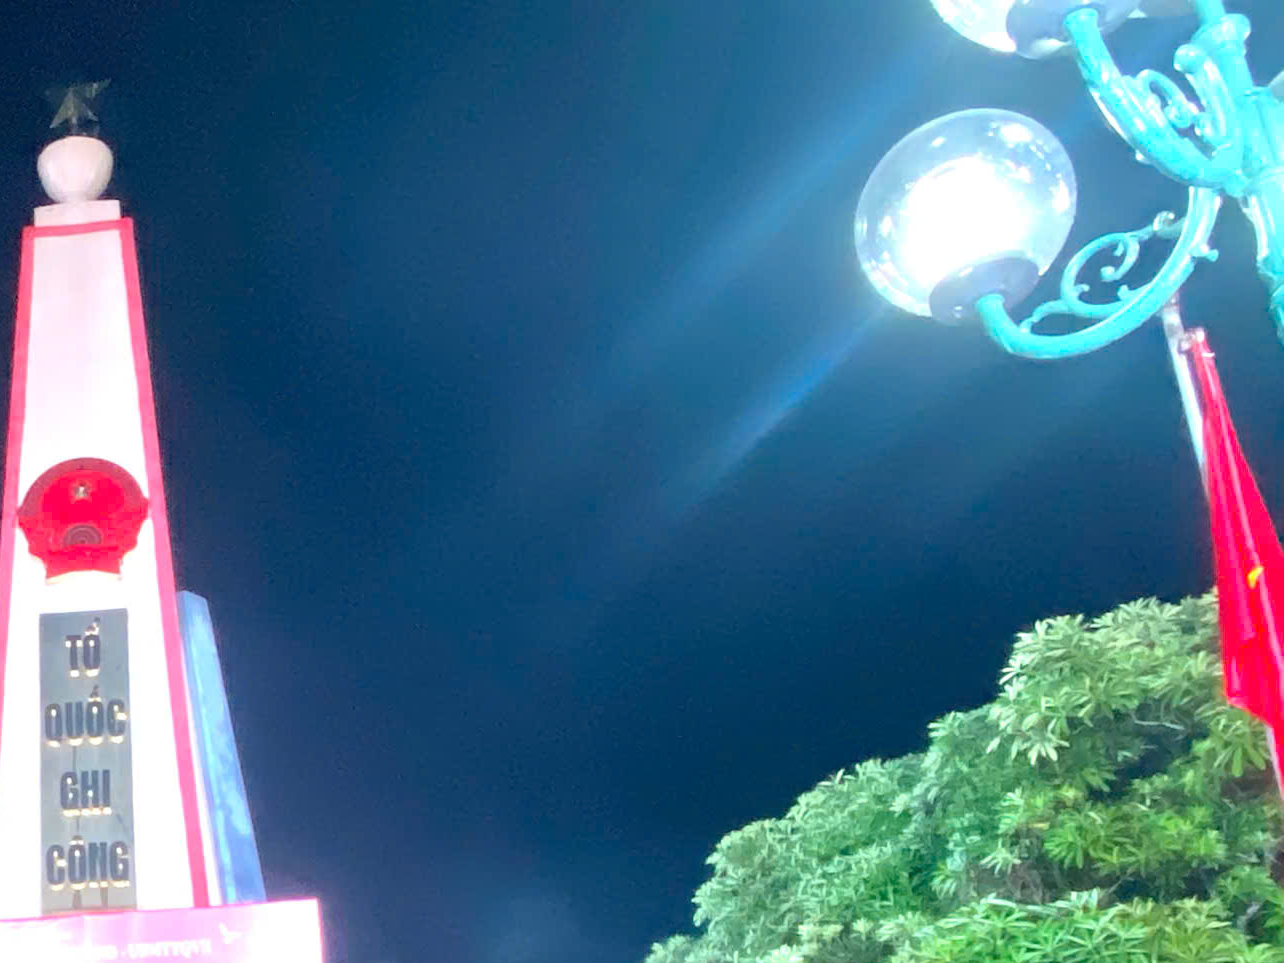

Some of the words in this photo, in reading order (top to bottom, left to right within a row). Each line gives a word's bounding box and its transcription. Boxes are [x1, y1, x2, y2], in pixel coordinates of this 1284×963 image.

[44, 685, 128, 744] QUỐC
[60, 769, 112, 812] GHI
[46, 836, 130, 888] CÔNG
